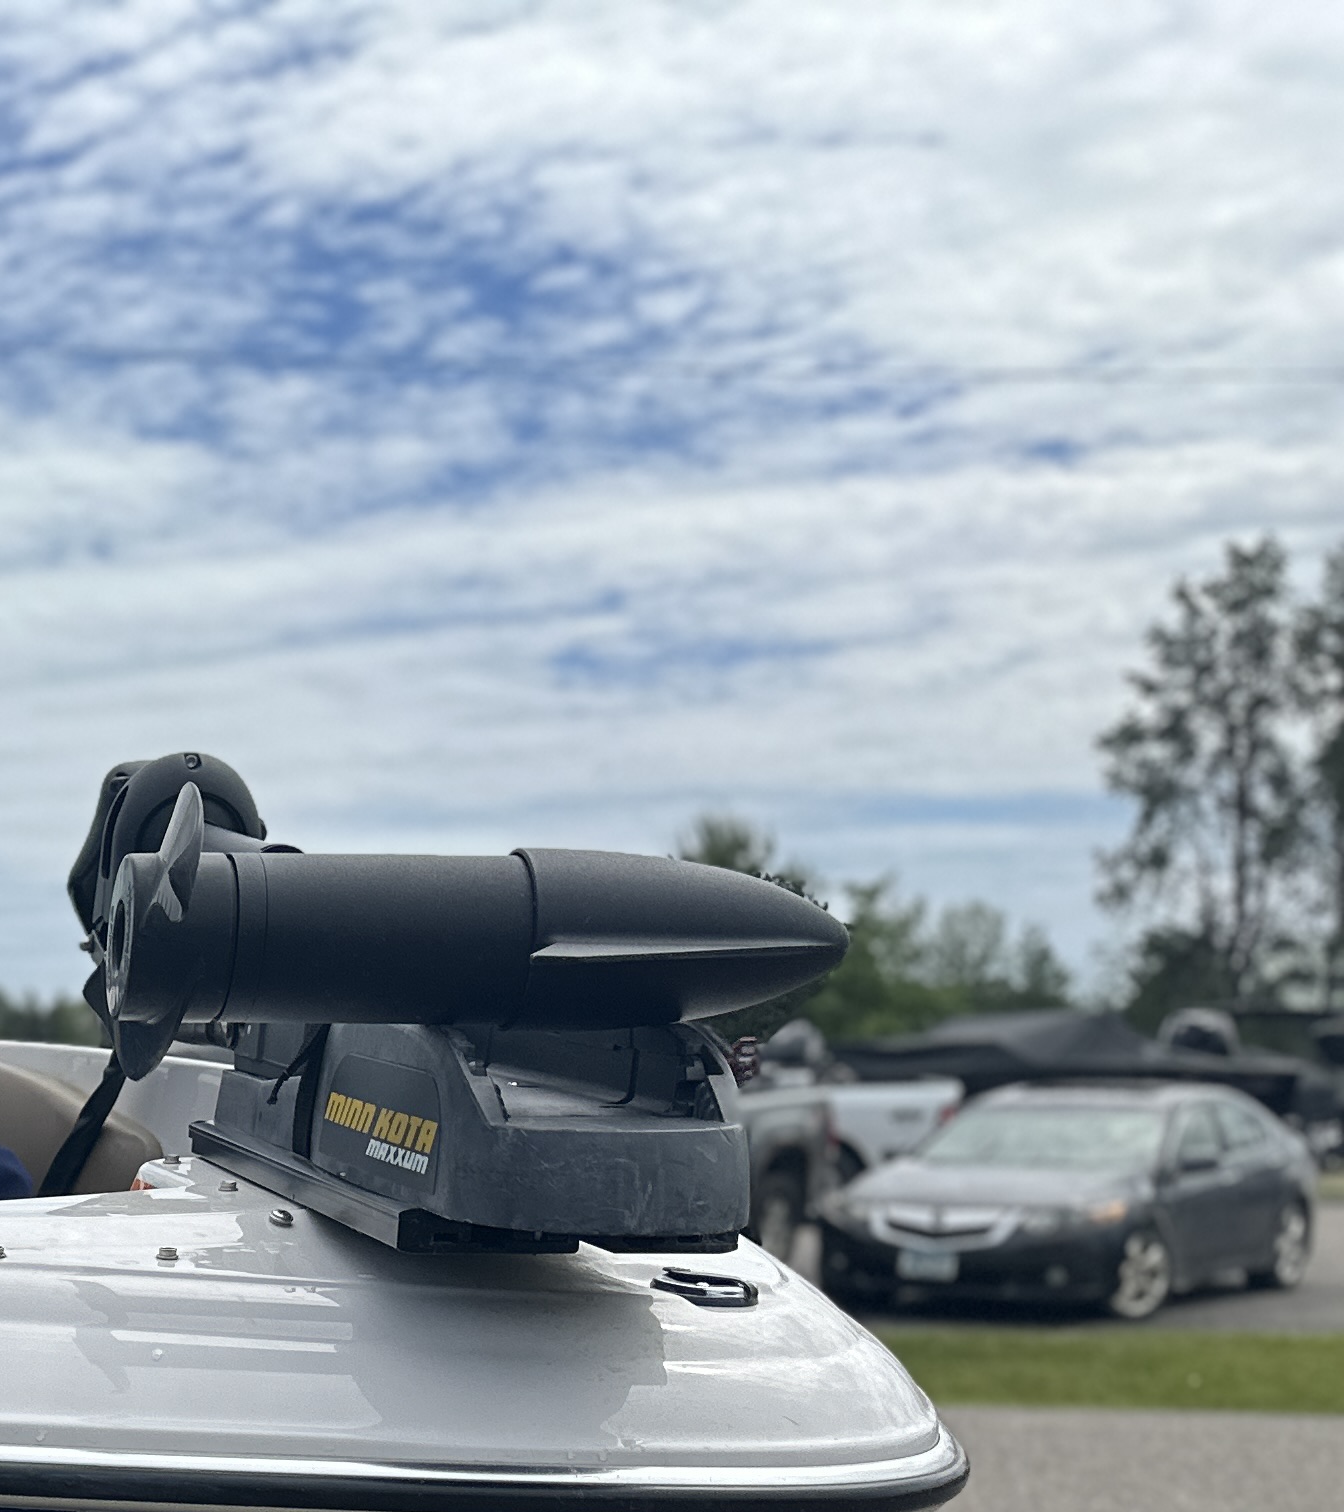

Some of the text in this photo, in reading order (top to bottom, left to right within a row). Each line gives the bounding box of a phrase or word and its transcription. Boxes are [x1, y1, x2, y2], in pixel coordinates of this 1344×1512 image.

[324, 1091, 439, 1154] MINN KOTA
[365, 1138, 429, 1175] MAXXUM
